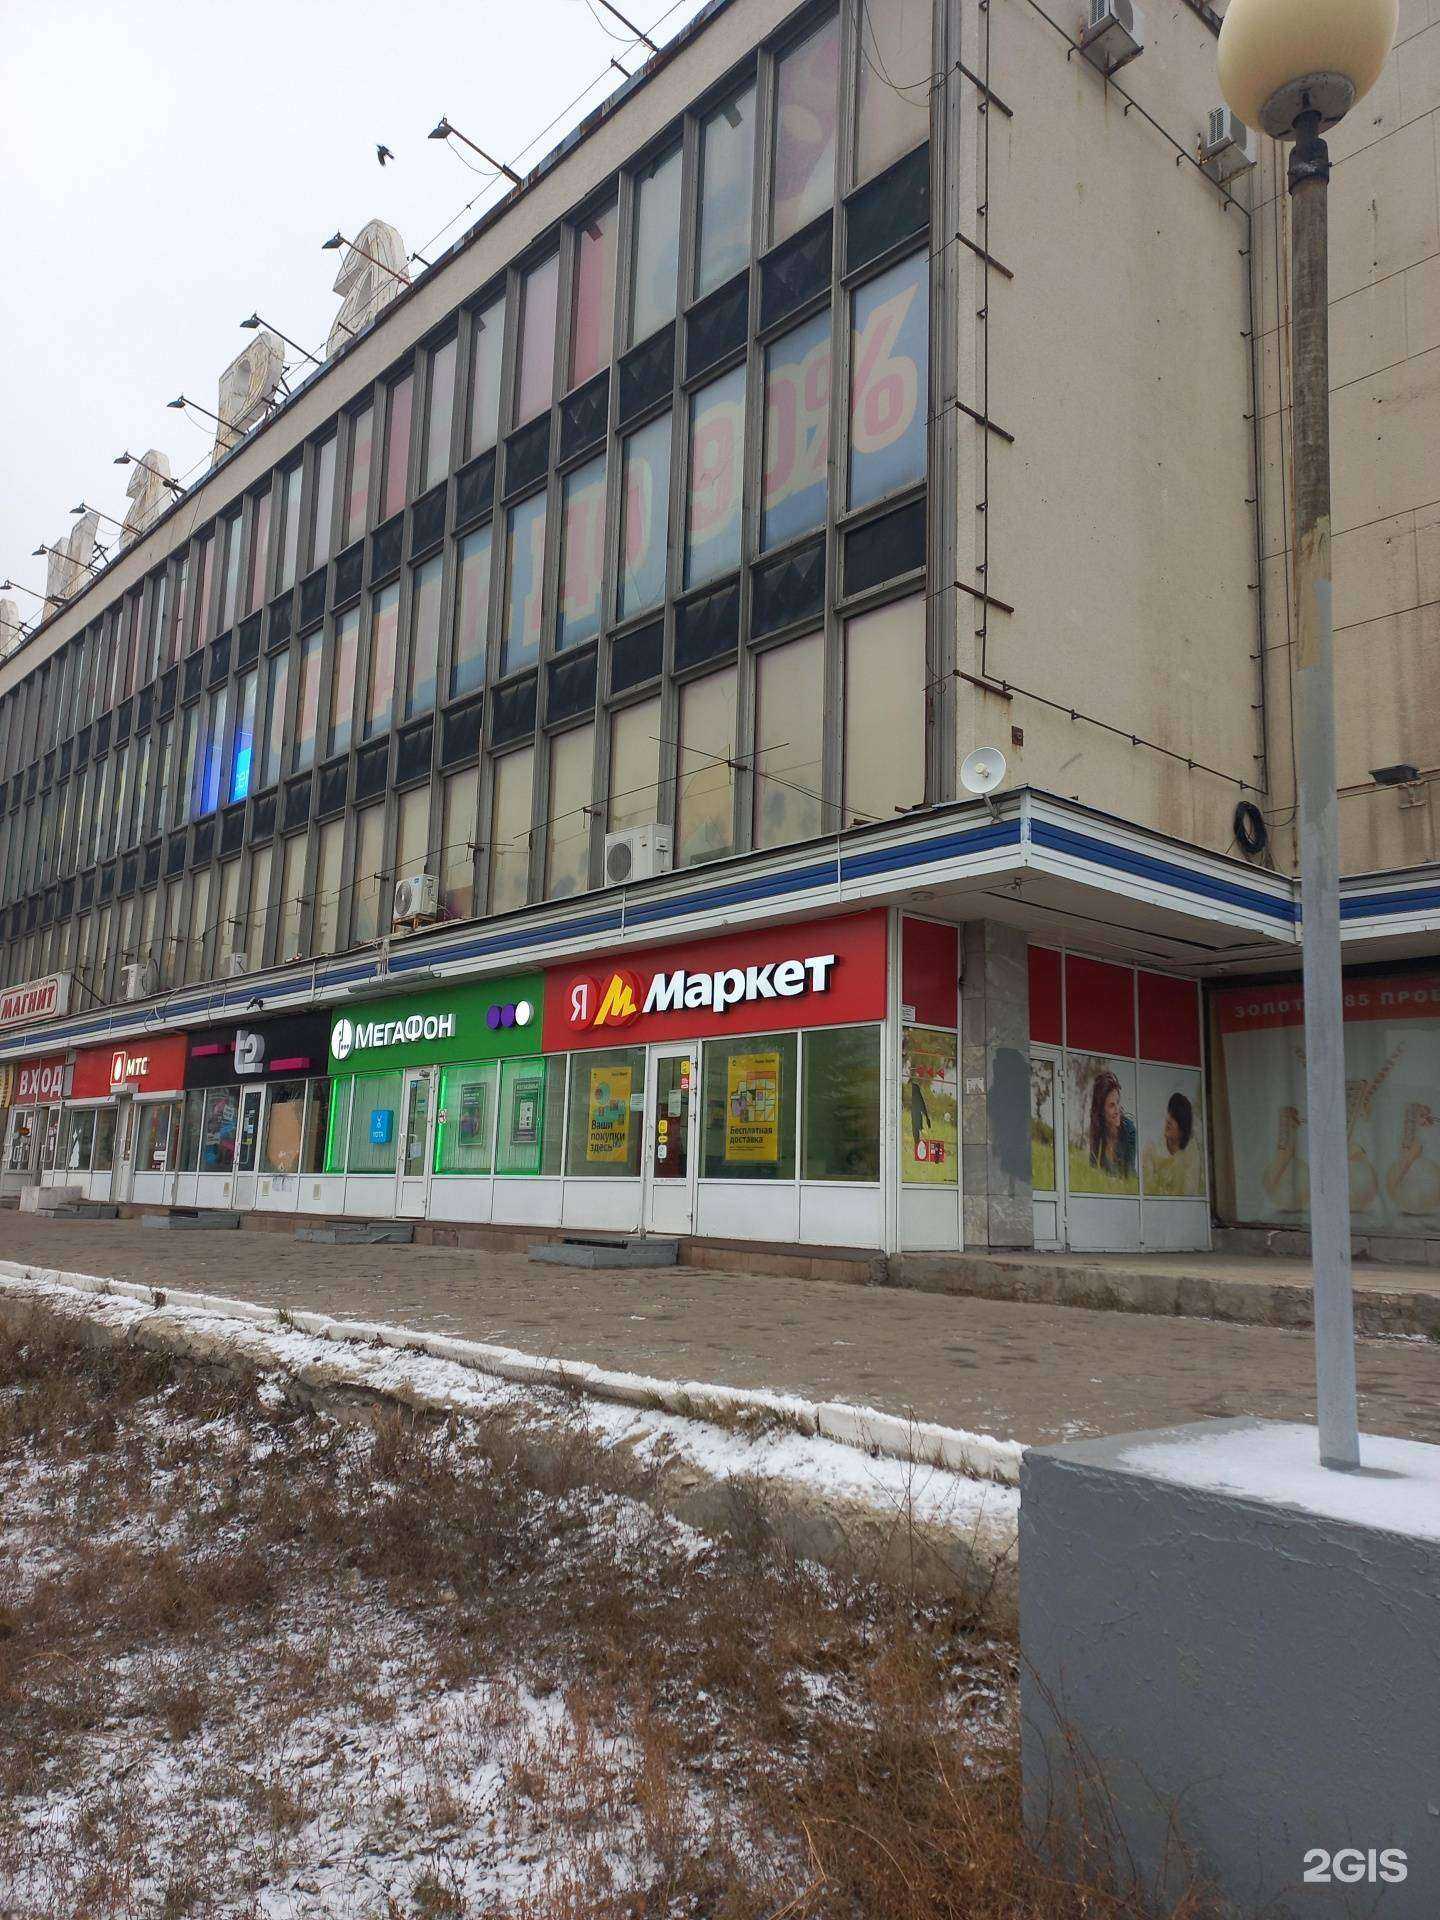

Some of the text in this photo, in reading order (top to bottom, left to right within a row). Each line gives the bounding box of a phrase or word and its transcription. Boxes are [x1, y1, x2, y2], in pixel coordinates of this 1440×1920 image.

[570, 984, 587, 1021] Я
[642, 954, 835, 1012] Маркет
[1, 986, 55, 1019] МАГНИТ
[126, 1057, 148, 1076] МТС
[19, 1066, 63, 1097] ВХОД
[591, 1120, 613, 1130] Ваши
[730, 1126, 773, 1135] Бесплатная
[590, 1131, 625, 1144] покупки
[730, 1135, 764, 1144] доставка
